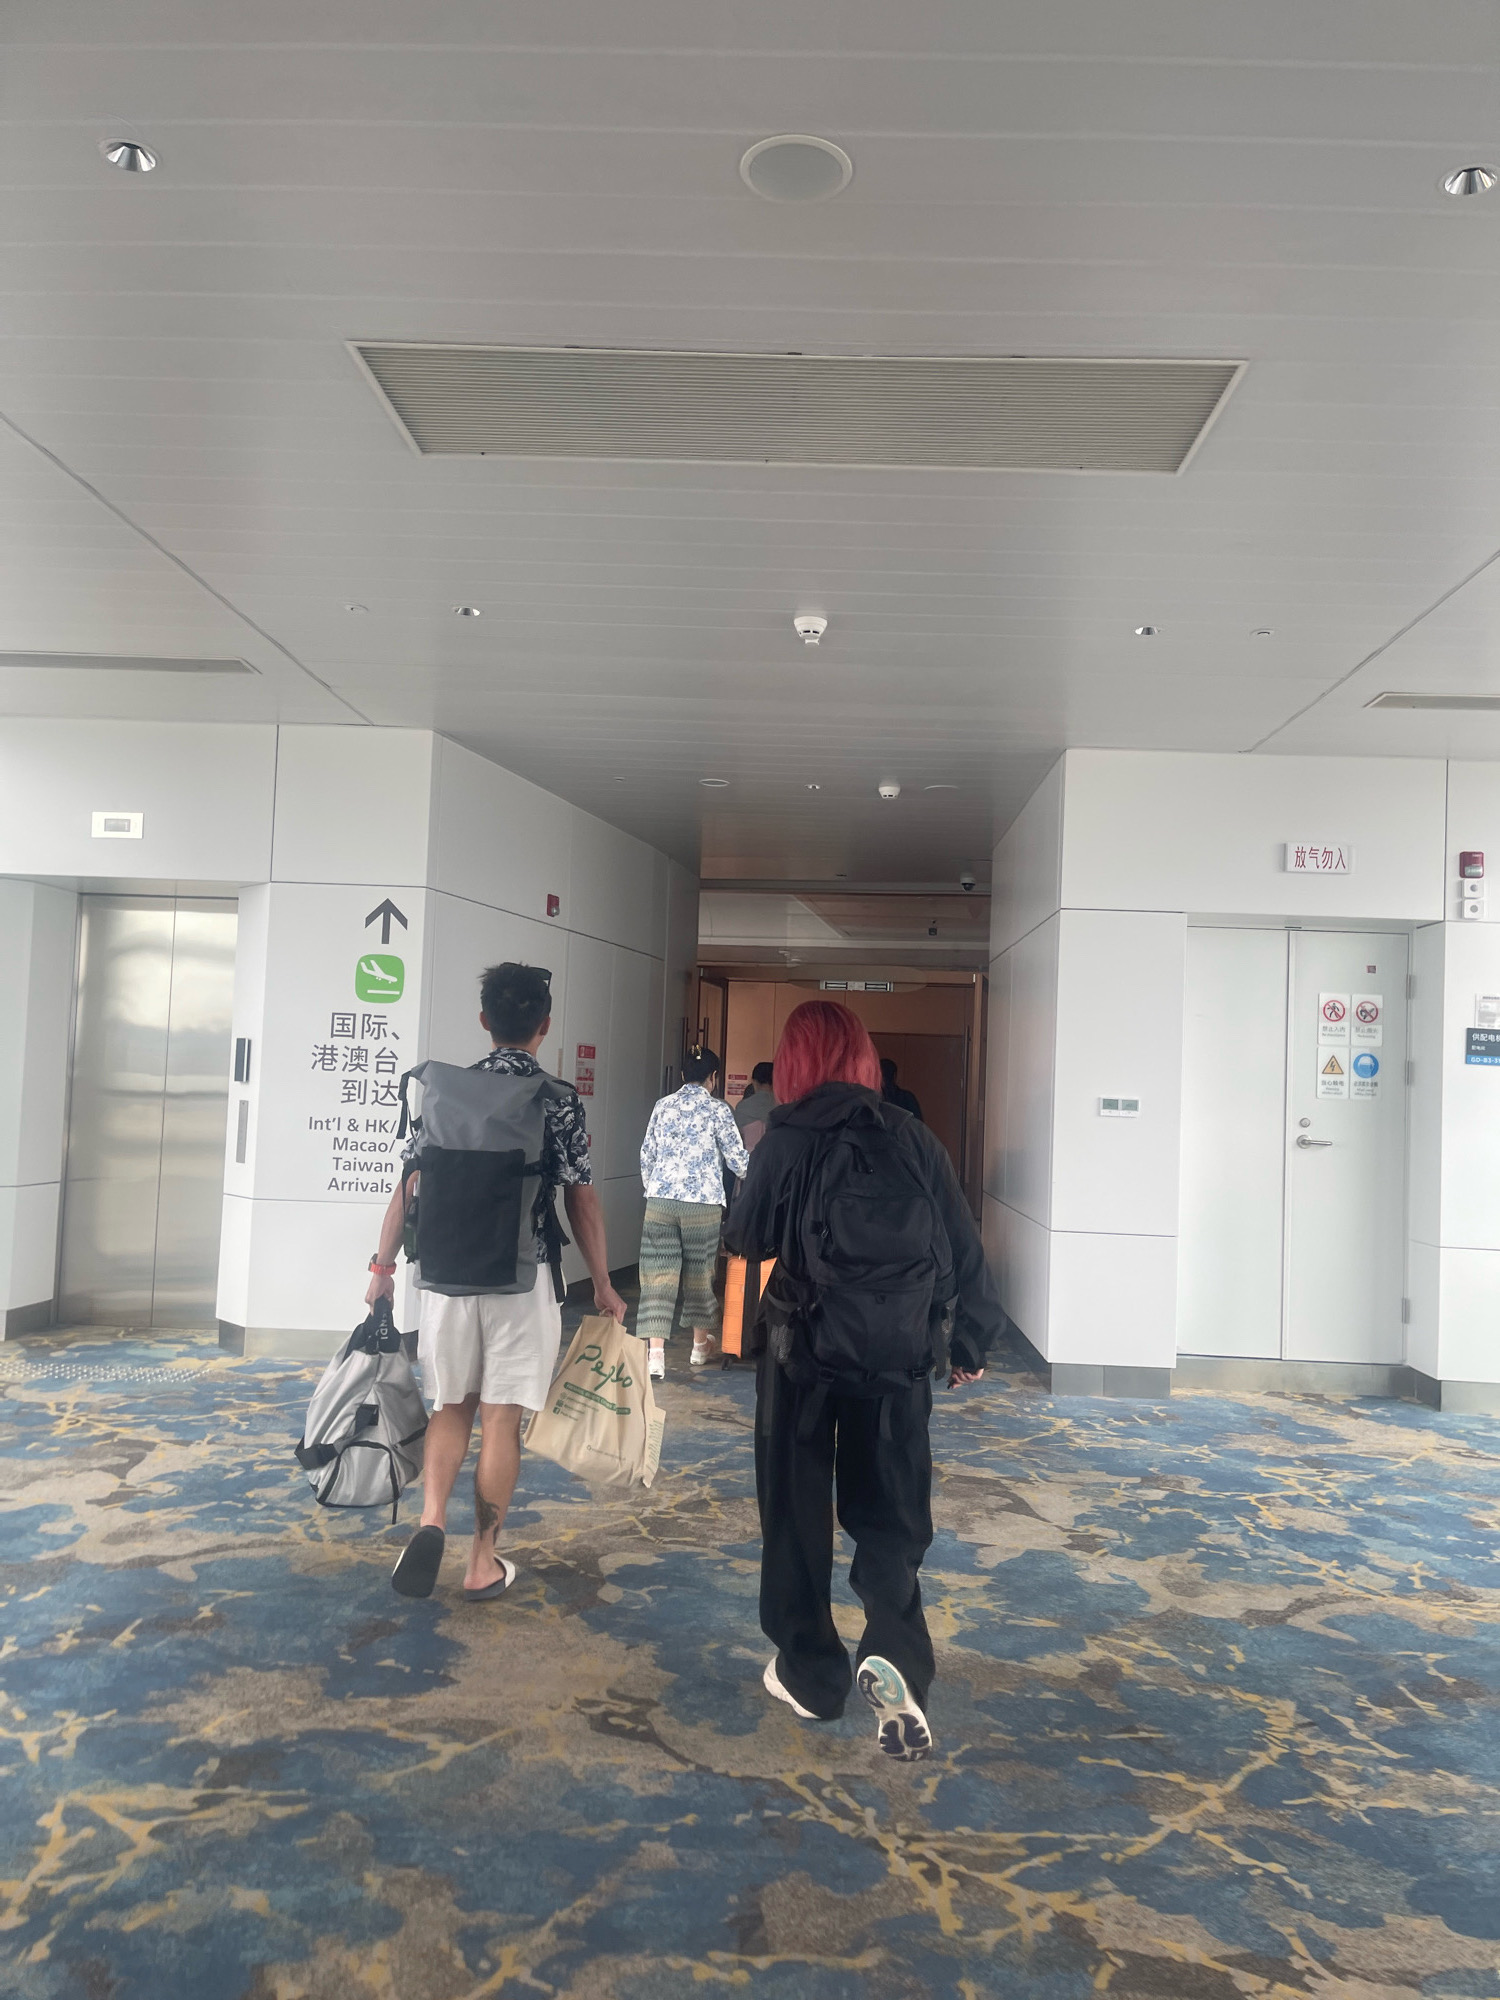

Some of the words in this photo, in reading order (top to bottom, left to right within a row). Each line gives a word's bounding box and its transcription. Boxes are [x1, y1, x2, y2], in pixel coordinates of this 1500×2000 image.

[1295, 846, 1346, 869] 放气勿入
[311, 1044, 399, 1074] 港澳台
[340, 1079, 399, 1106] 到达
[309, 1116, 341, 1131] Int'l
[347, 1118, 359, 1132] &
[365, 1119, 397, 1134] HK/
[333, 1137, 396, 1153] Macao/
[332, 1157, 394, 1173] Taiwan
[327, 1177, 392, 1194] Arrivals
